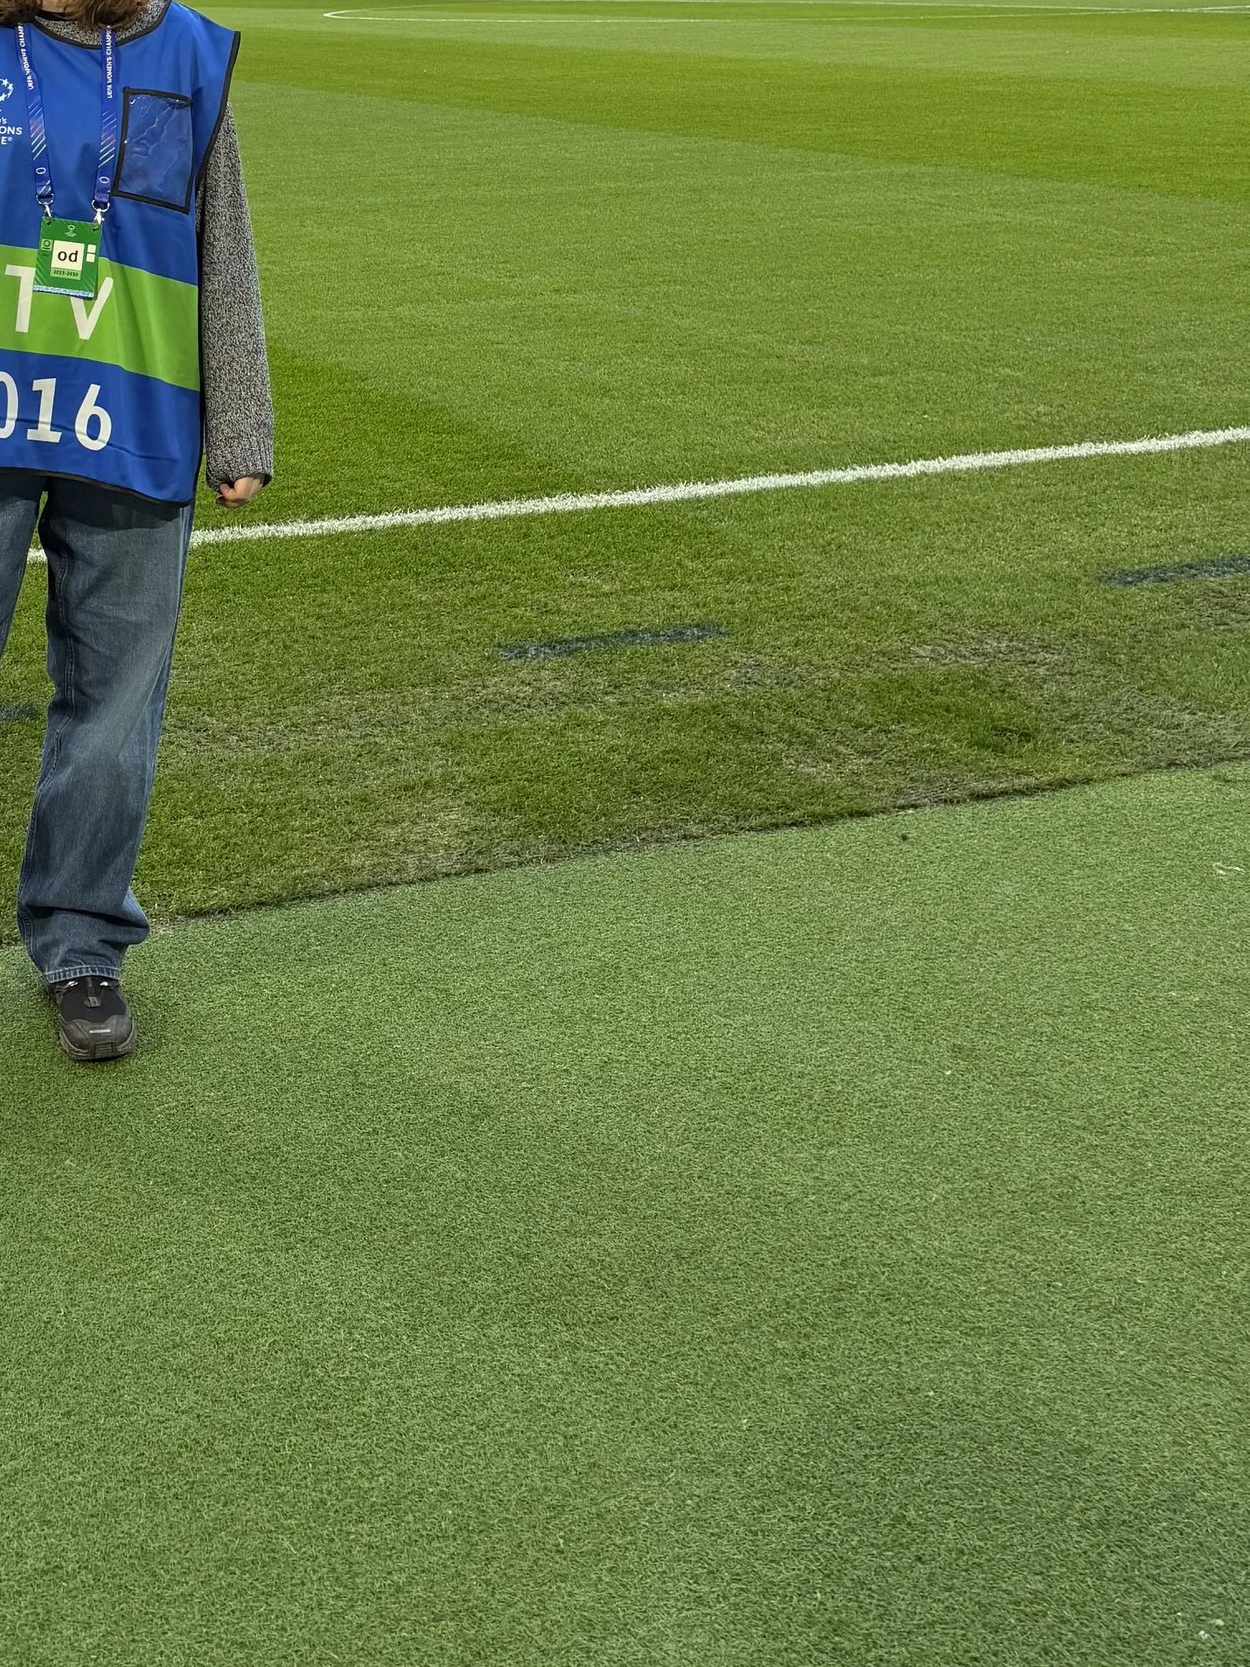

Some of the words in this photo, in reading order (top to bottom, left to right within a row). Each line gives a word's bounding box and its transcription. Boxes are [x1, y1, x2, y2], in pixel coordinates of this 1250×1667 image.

[26, 75, 34, 91] UEFA
[57, 250, 79, 263] od
[4, 264, 114, 341] TV
